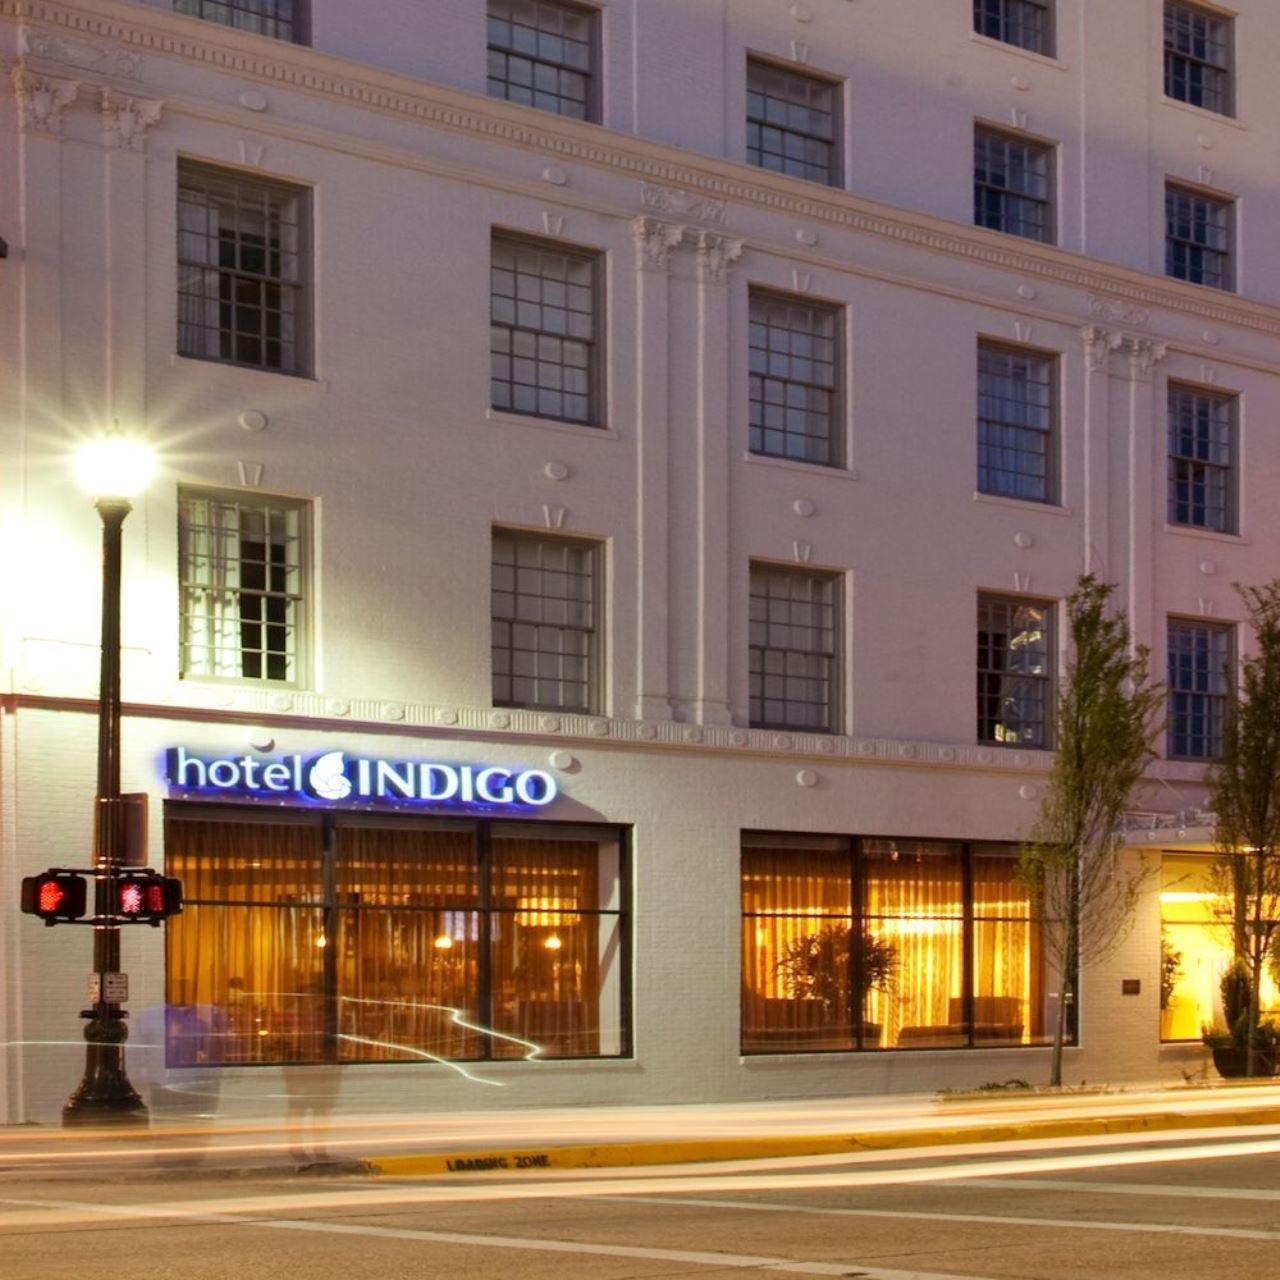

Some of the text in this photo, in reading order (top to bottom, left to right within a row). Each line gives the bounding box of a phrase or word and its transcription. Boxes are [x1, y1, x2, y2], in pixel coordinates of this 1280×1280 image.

[177, 747, 558, 806] hotel INDIGO
[445, 1154, 552, 1172] LOADING ZONE
